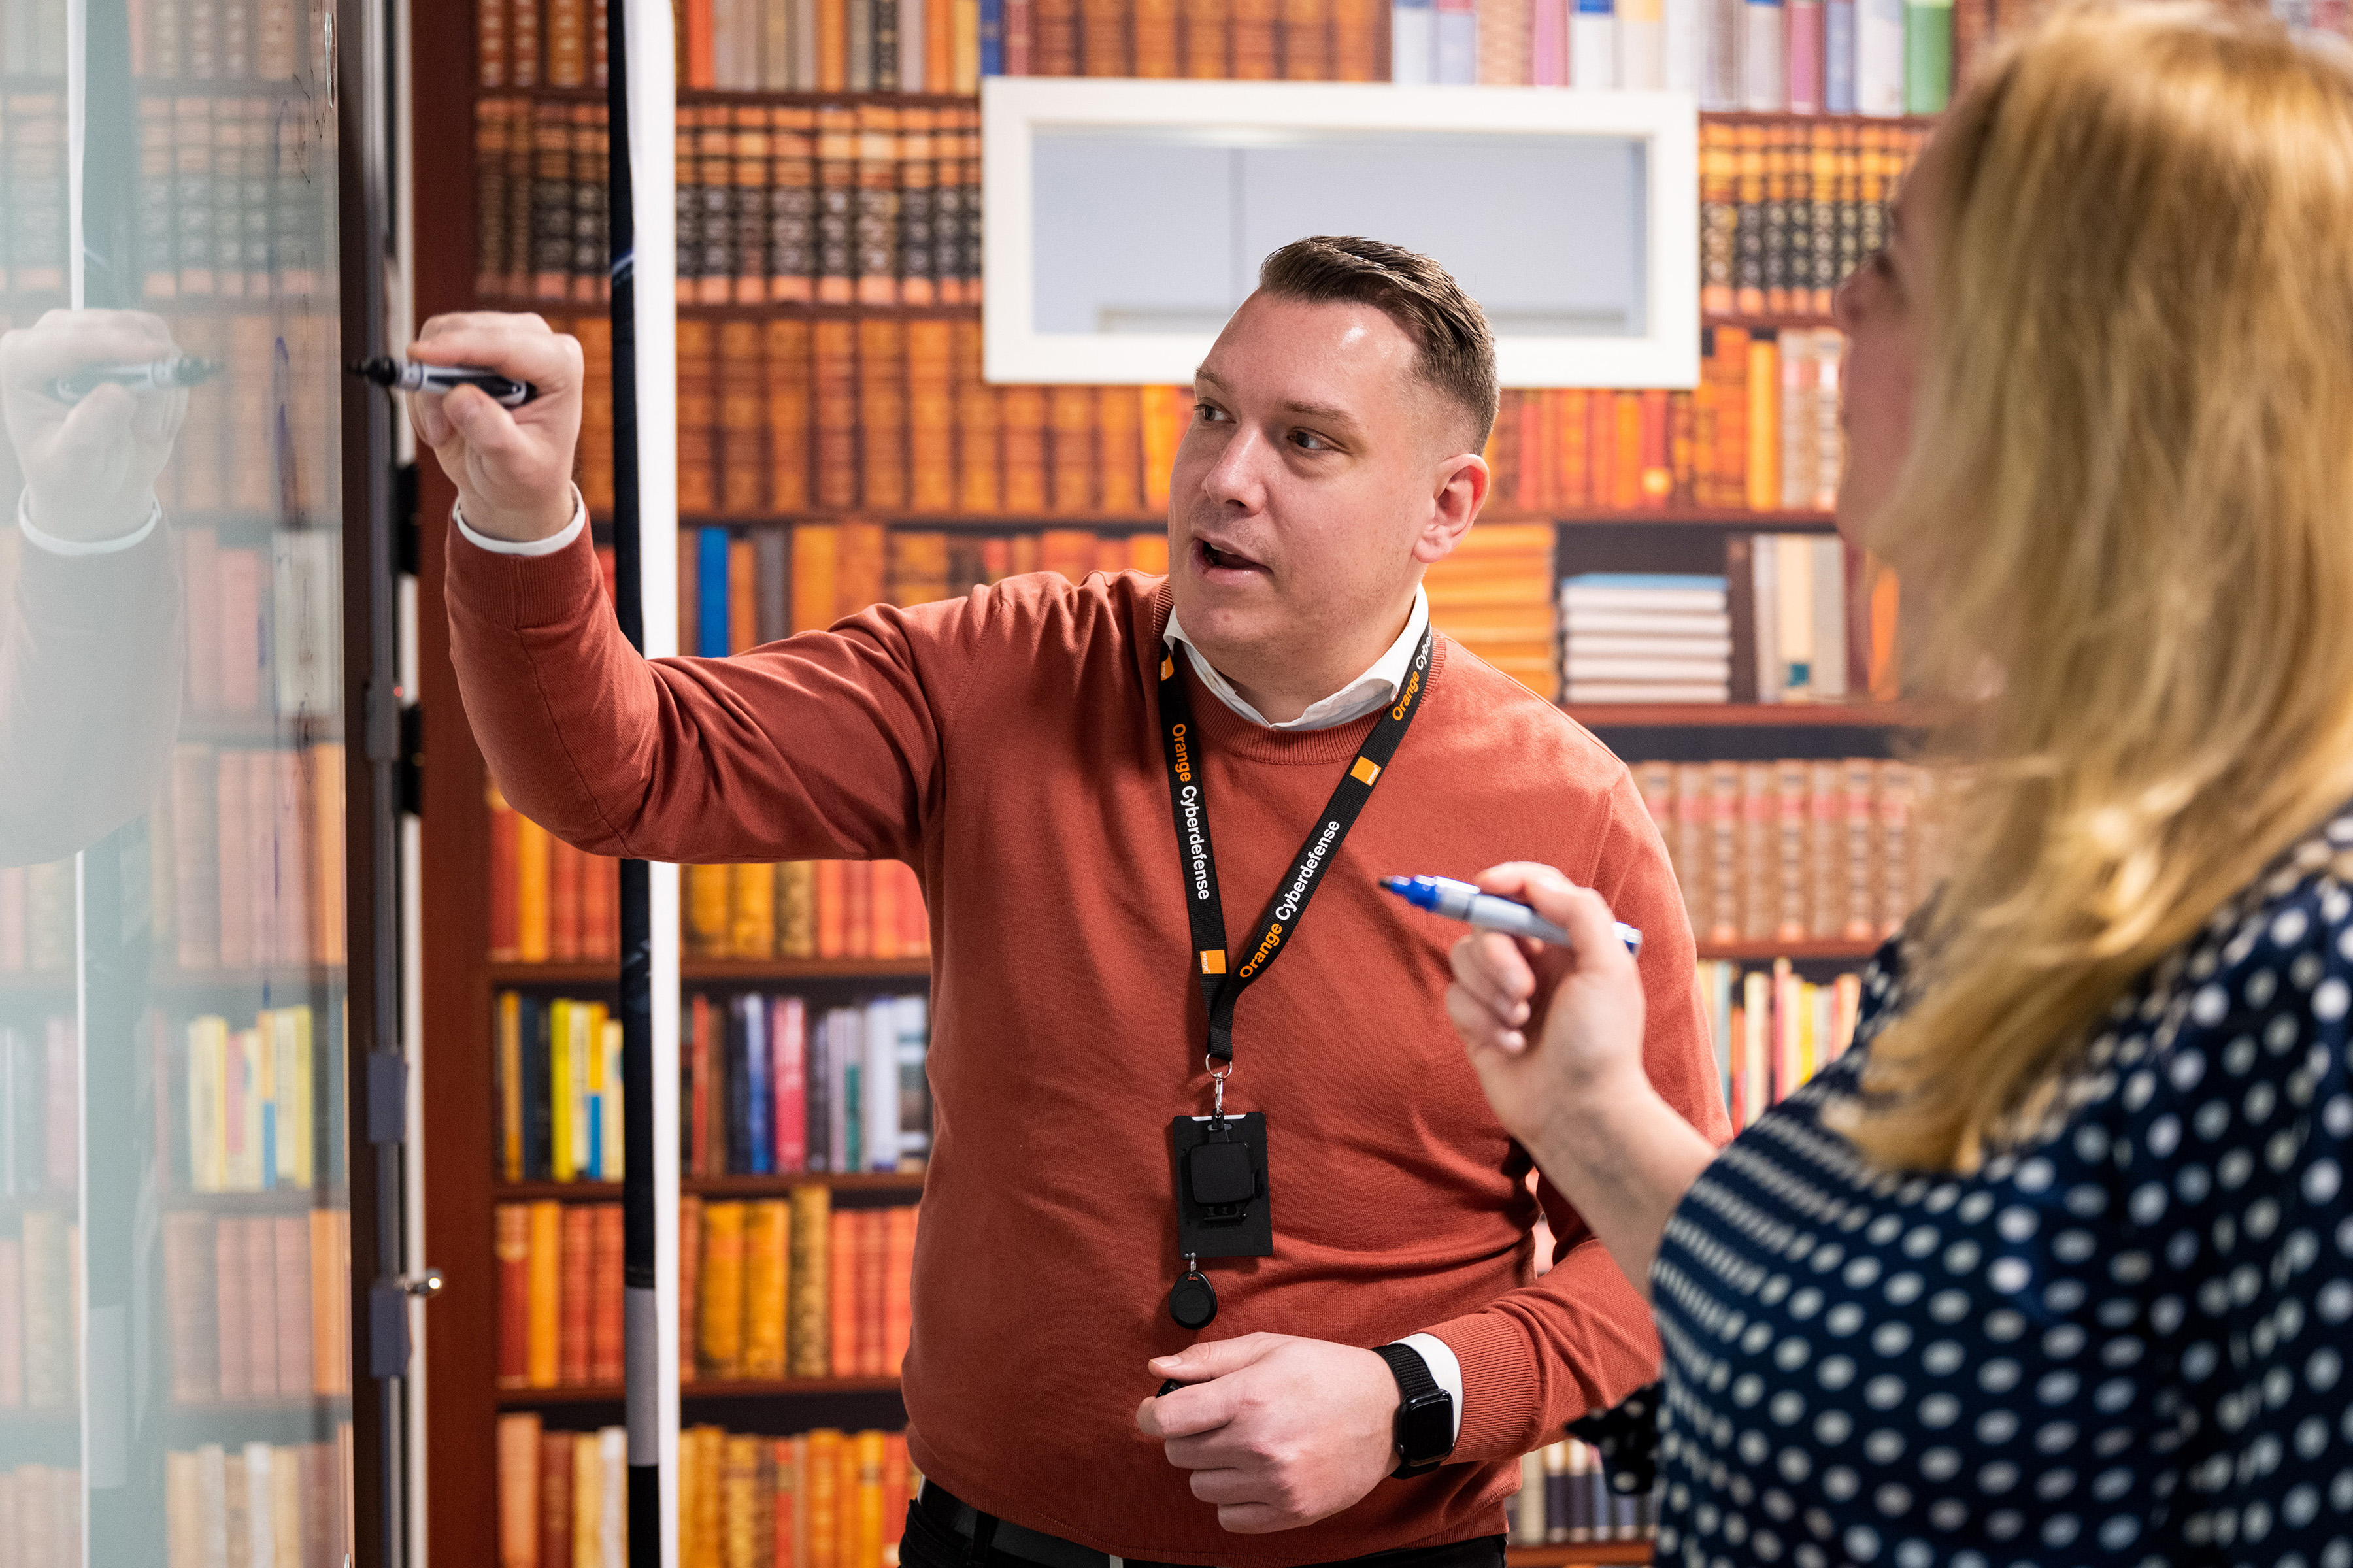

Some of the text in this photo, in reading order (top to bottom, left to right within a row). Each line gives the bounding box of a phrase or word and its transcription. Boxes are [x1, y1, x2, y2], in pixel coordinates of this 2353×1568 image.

[1392, 671, 1420, 720] Orange
[1172, 723, 1209, 900] Orange Cyberdefense
[1239, 820, 1340, 978] Orange Cyberdefense
